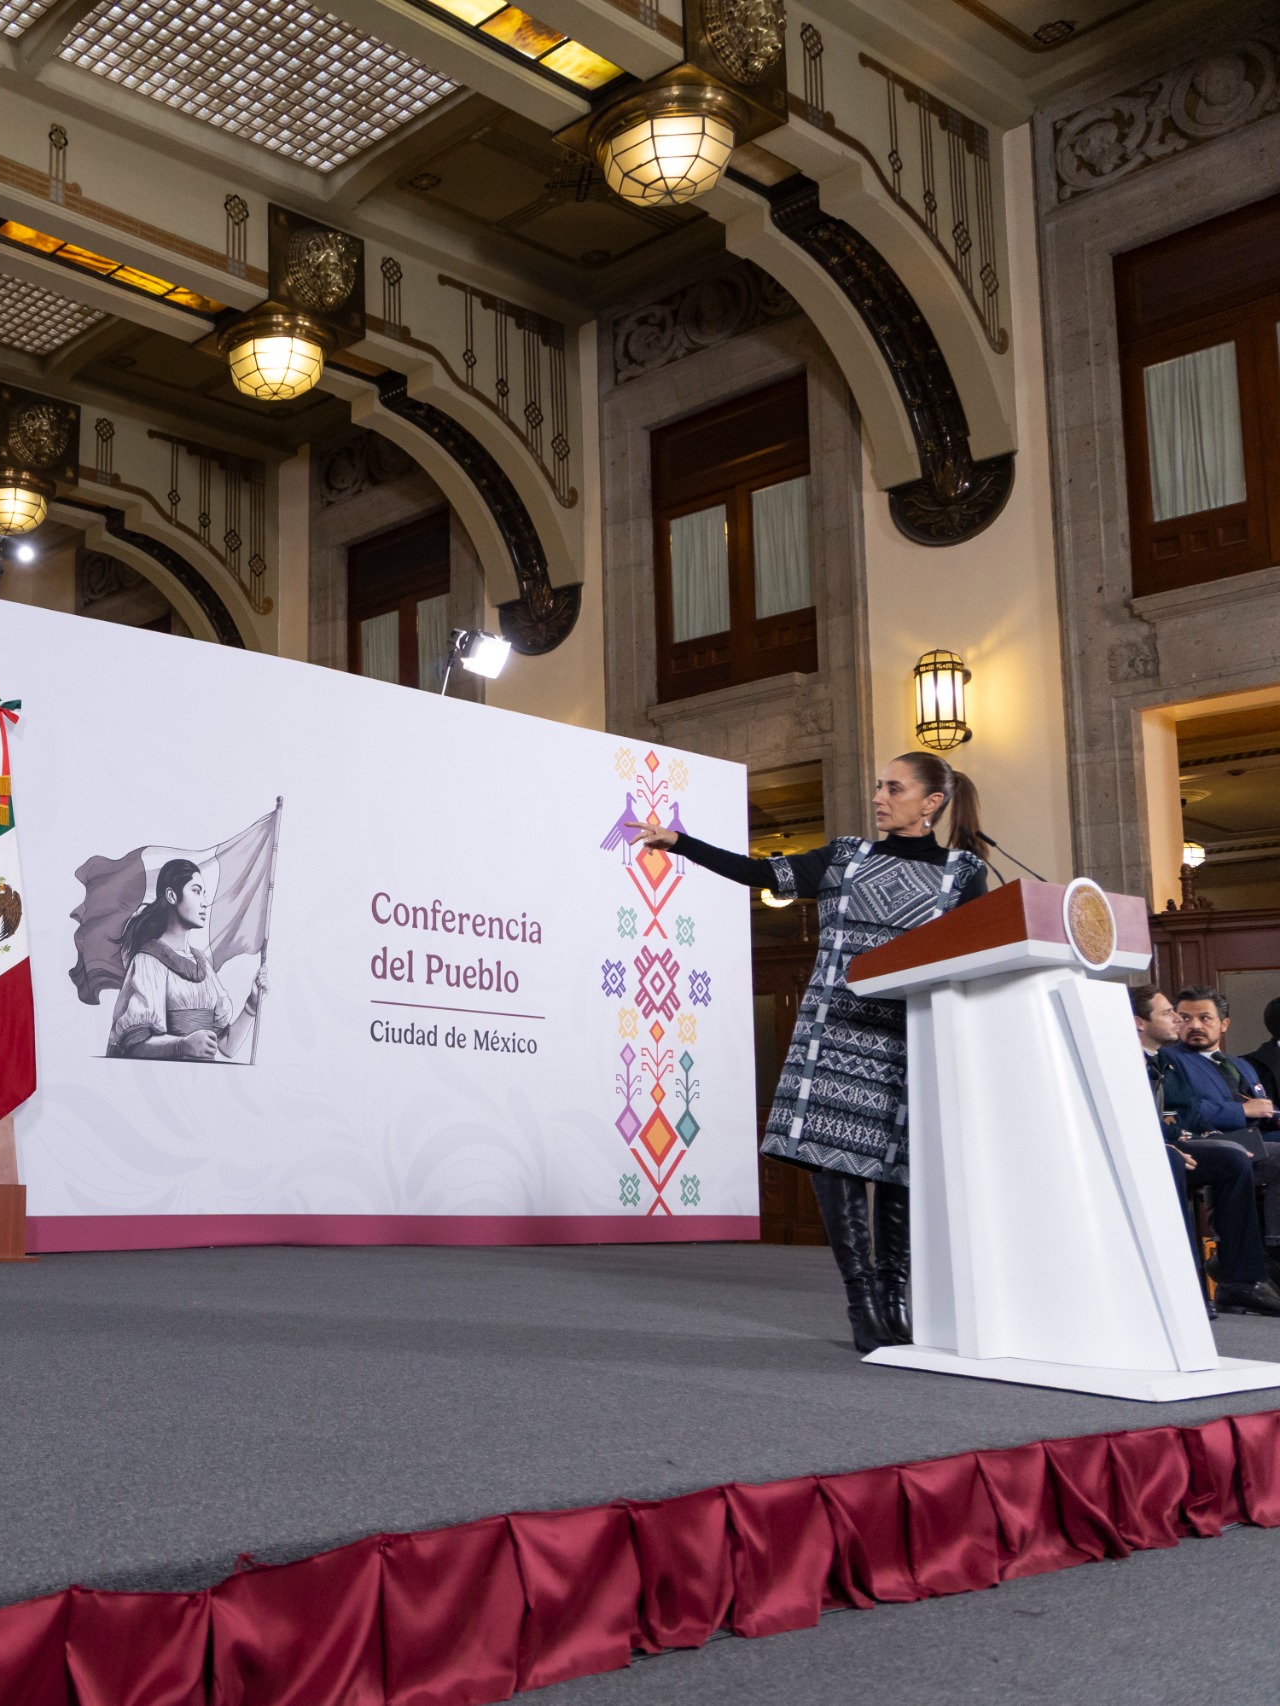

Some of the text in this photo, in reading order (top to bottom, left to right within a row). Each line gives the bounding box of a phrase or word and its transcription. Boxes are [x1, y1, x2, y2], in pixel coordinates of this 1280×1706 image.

[371, 892, 542, 944] Conferencia
[370, 946, 519, 993] del Pueblo
[370, 1020, 538, 1055] Ciudad de México
